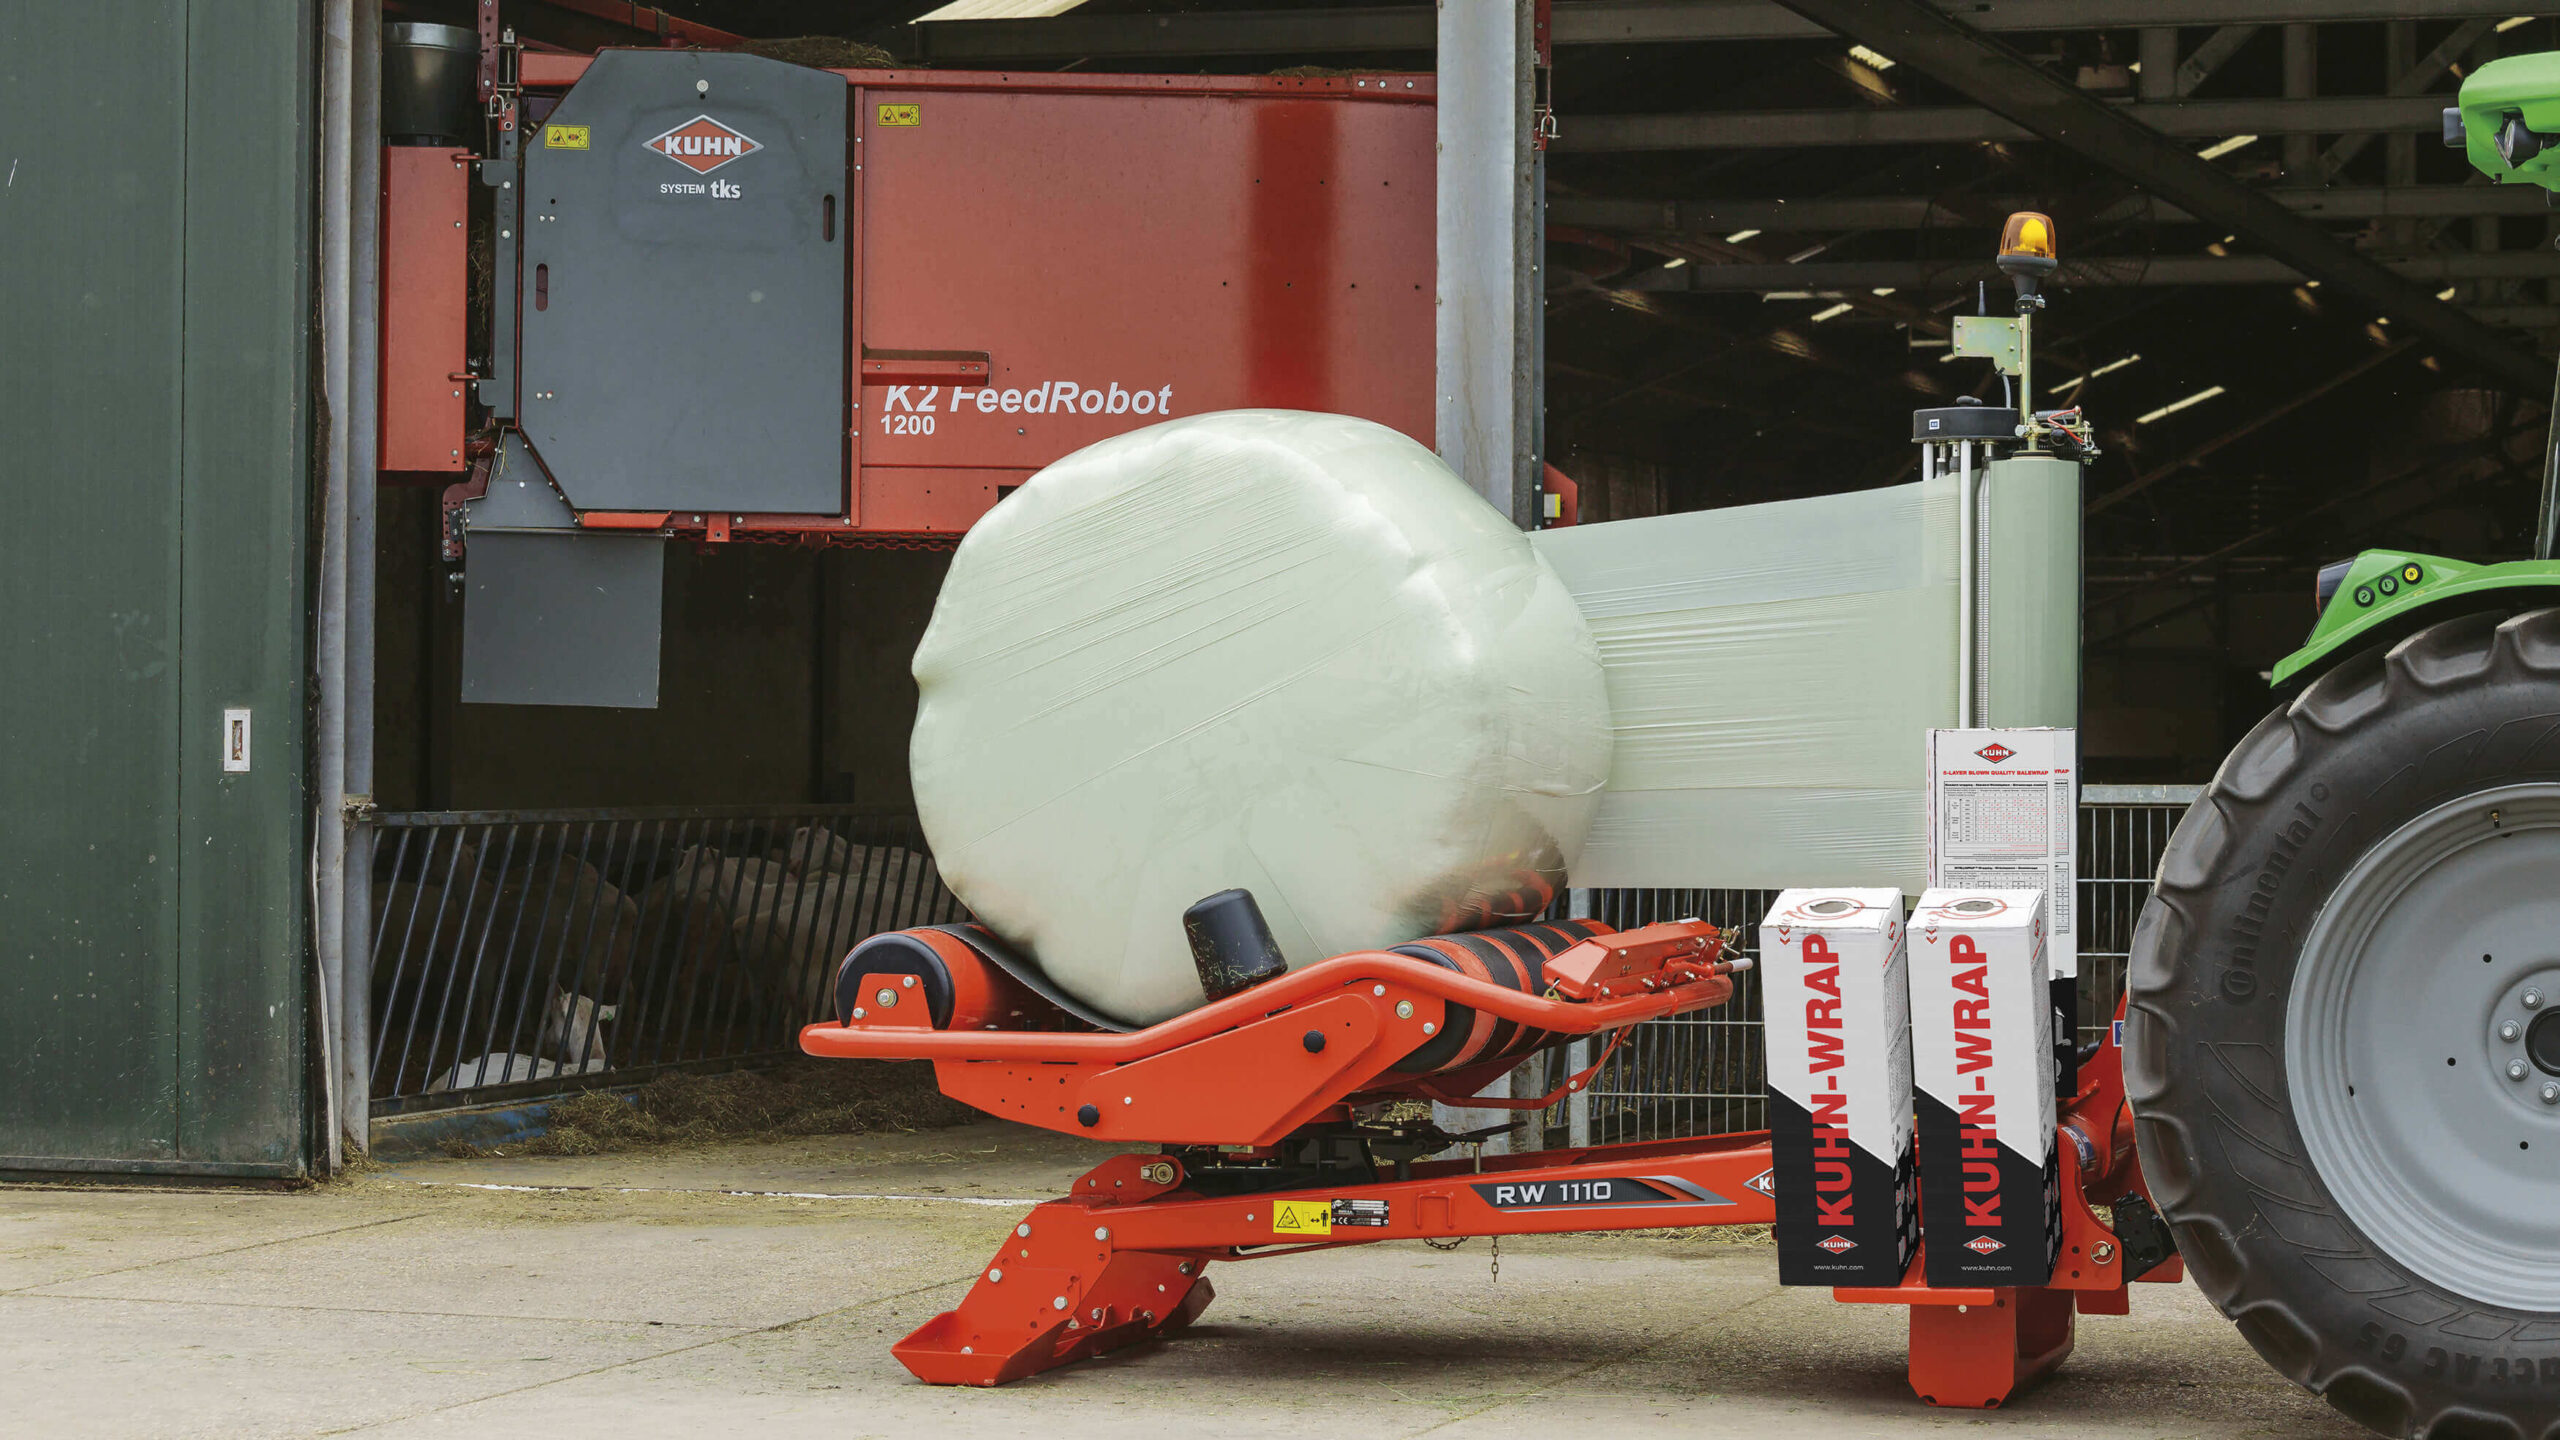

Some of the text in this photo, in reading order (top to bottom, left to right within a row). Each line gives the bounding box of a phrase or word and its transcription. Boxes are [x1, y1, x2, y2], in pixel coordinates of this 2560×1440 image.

[665, 135, 742, 156] KUHN
[660, 179, 741, 199] SYSTEM tks
[884, 381, 1173, 415] K2 FeedRobot
[881, 415, 936, 435] 1200
[1981, 749, 2009, 757] KUHN
[1801, 933, 1854, 1226] KUHN-WRAP
[1949, 934, 2002, 1227] KUHN-WRAP
[1496, 1181, 1612, 1204] RW 1110
[1759, 1176, 1775, 1190] K
[1823, 1241, 1851, 1249] KUHN
[1970, 1241, 1999, 1250] KUHN
